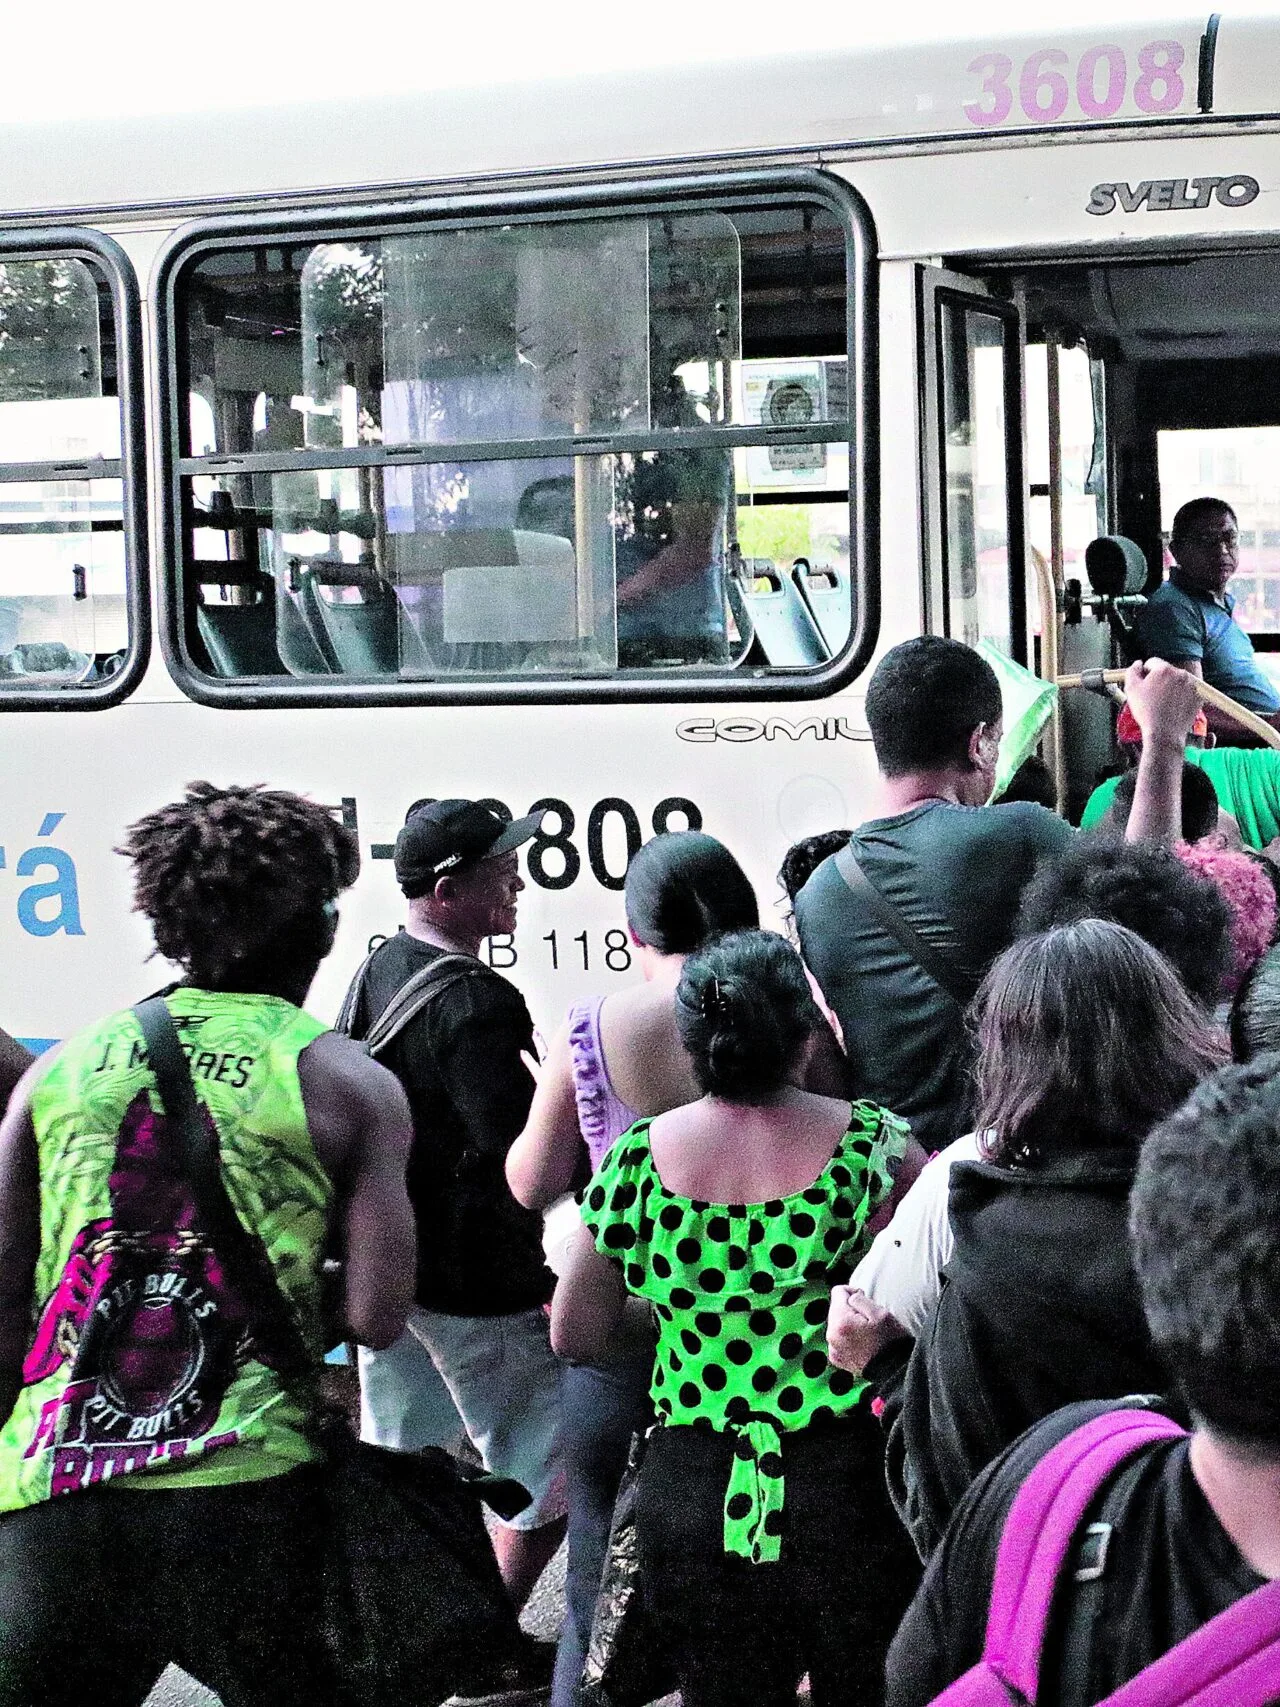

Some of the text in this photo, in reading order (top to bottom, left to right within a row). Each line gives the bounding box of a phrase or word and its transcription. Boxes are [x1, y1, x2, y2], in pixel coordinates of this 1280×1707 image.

[963, 40, 1184, 127] 3608
[1086, 174, 1261, 215] SVELTO
[676, 717, 873, 742] COMIL
[0, 812, 86, 937] á
[542, 929, 632, 971] 118
